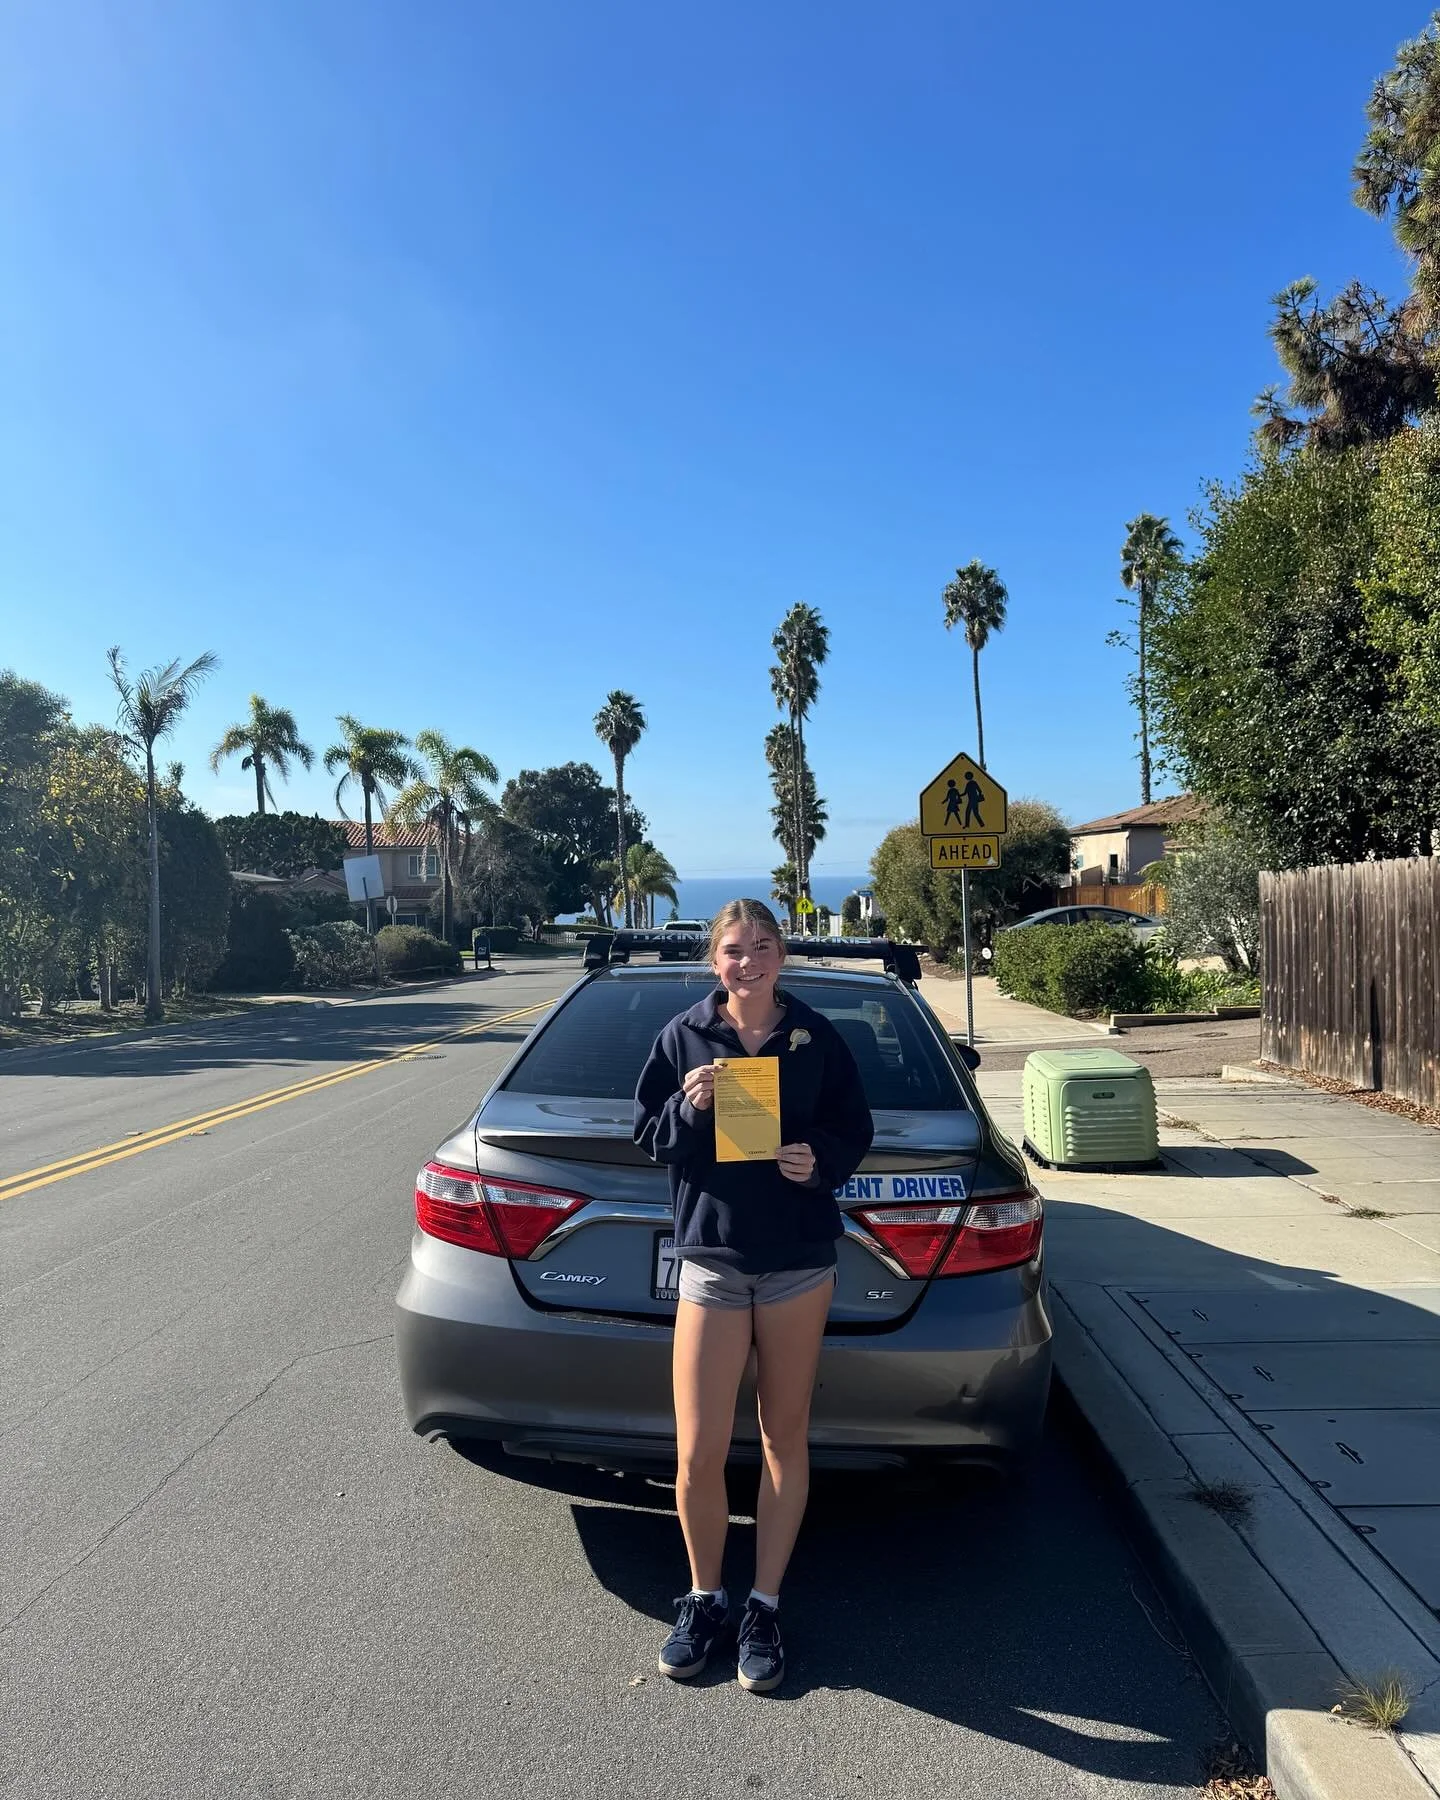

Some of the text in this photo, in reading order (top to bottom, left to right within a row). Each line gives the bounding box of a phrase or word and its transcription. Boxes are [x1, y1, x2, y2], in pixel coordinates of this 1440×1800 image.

[939, 844, 992, 860] AHEAD
[892, 1177, 965, 1198] DRIVER
[540, 1271, 607, 1286] CAMRY
[866, 1291, 895, 1299] SE
